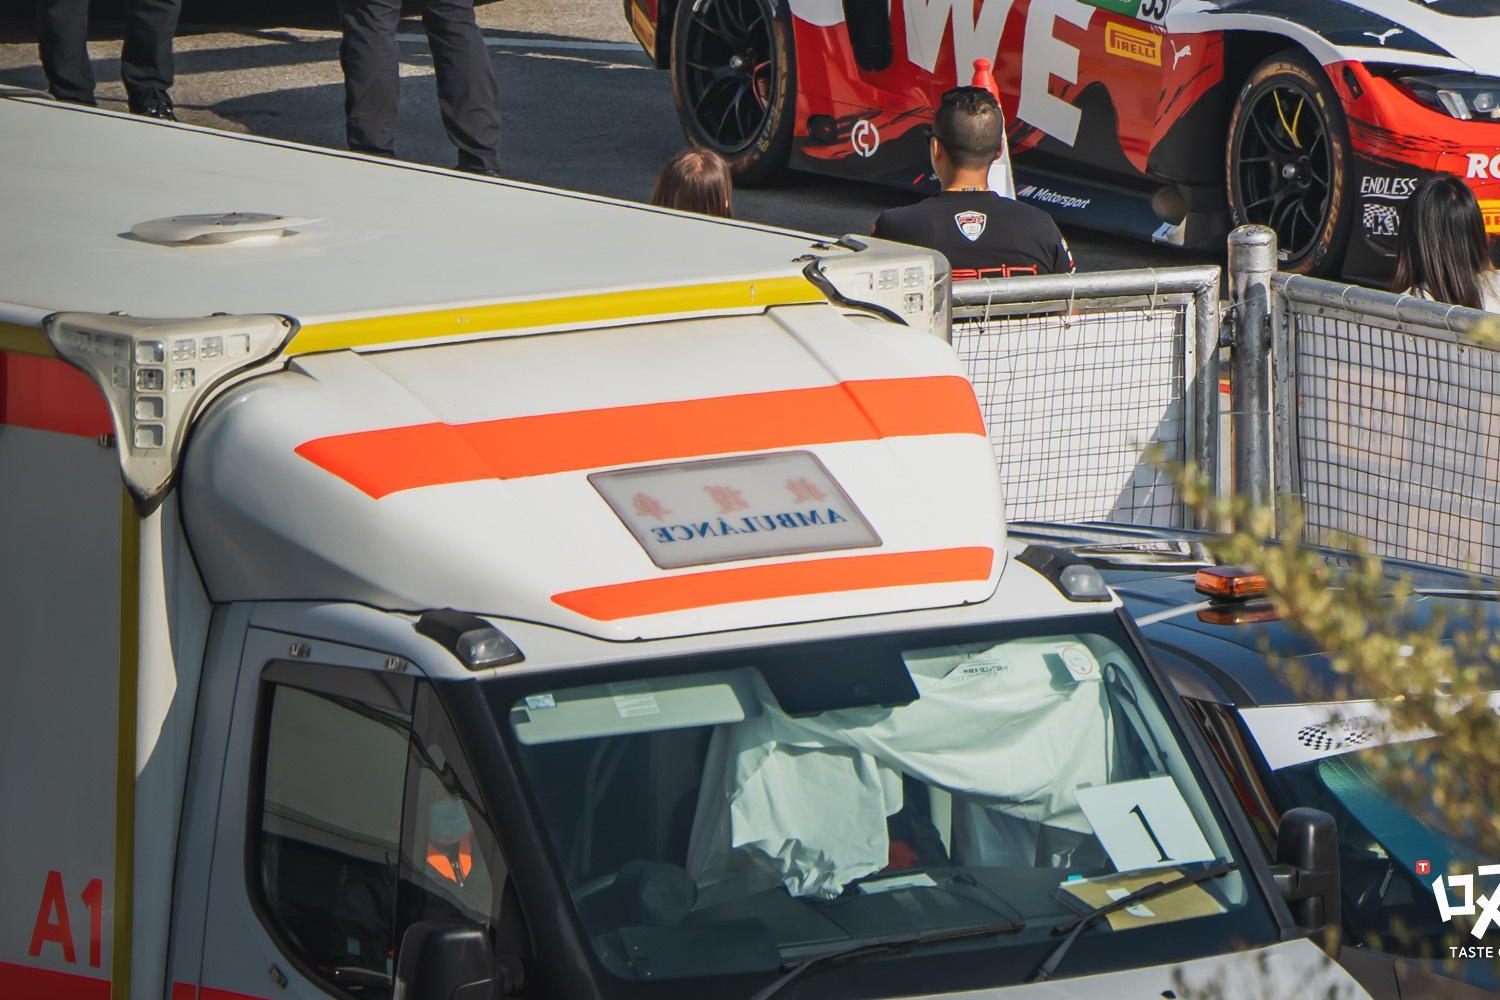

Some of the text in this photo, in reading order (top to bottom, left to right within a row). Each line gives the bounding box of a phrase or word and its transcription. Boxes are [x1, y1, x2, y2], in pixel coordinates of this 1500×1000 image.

[1110, 28, 1157, 60] PIRELLI
[1034, 188, 1091, 209] Motorsport
[1360, 176, 1418, 198] ENDLESS
[1128, 803, 1175, 863] 1
[28, 869, 104, 968] A1
